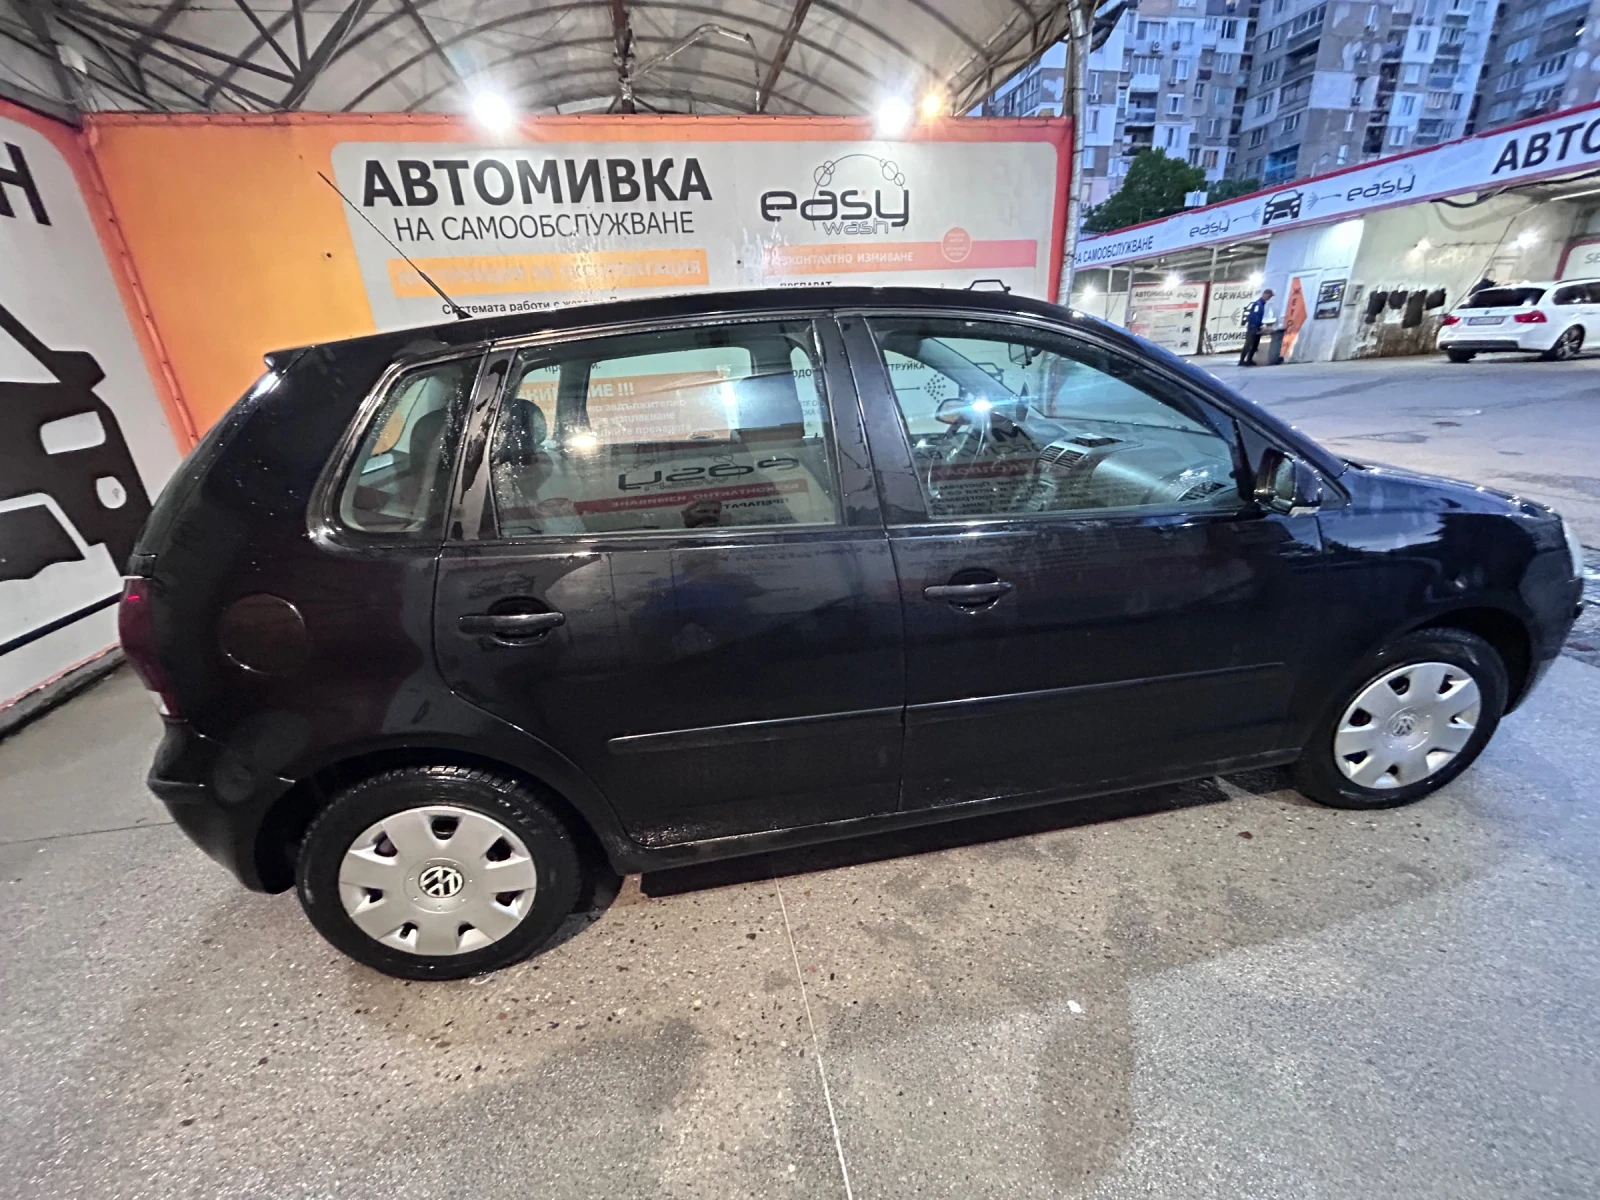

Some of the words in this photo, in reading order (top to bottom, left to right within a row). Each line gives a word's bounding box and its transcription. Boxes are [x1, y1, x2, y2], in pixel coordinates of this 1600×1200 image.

[362, 157, 713, 207] АВТОМИВКА
[1347, 175, 1416, 201] easy
[760, 189, 910, 228] easy
[393, 217, 434, 242] НА
[441, 210, 695, 241] САМООБСЛУЖВАНЕ
[822, 218, 889, 236] wash
[1189, 219, 1230, 238] easy
[771, 253, 853, 266] ЗКОНТАКТНО
[857, 252, 914, 263] ИЗМИВАНЕ
[442, 303, 506, 315] Стемата
[509, 300, 550, 312] работи
